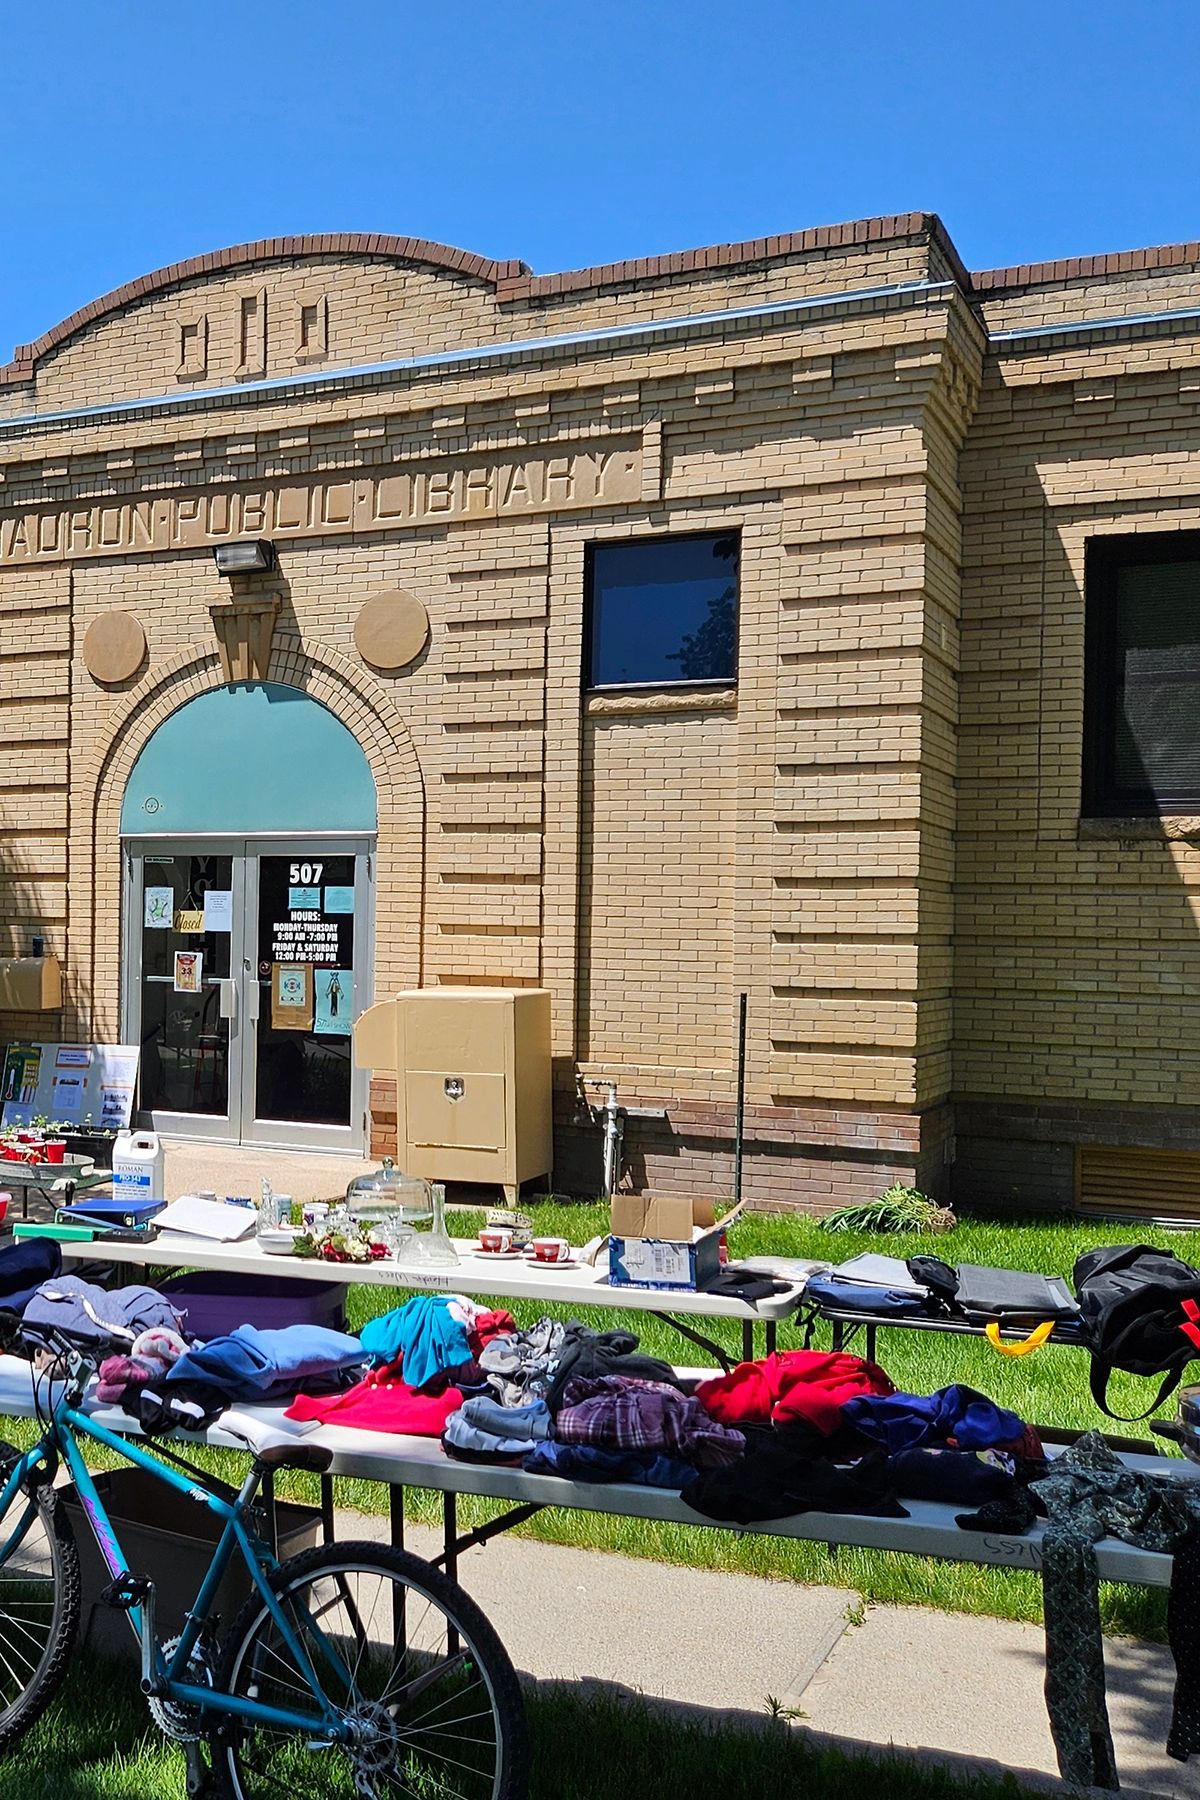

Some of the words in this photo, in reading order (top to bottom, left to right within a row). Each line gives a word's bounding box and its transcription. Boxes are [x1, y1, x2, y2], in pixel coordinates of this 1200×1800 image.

[173, 480, 352, 543] PUBLIC
[372, 450, 617, 522] LIBRARY
[289, 862, 323, 884] 507
[173, 912, 202, 930] Closed
[290, 911, 321, 921] HOURS:
[277, 932, 293, 941] 9:00
[294, 932, 306, 941] AM
[326, 933, 338, 942] PM
[272, 943, 296, 952] FRIDAY
[297, 943, 303, 951] &
[304, 943, 338, 952] SATURDAY
[275, 952, 295, 961] 12:00
[325, 953, 337, 961] PM
